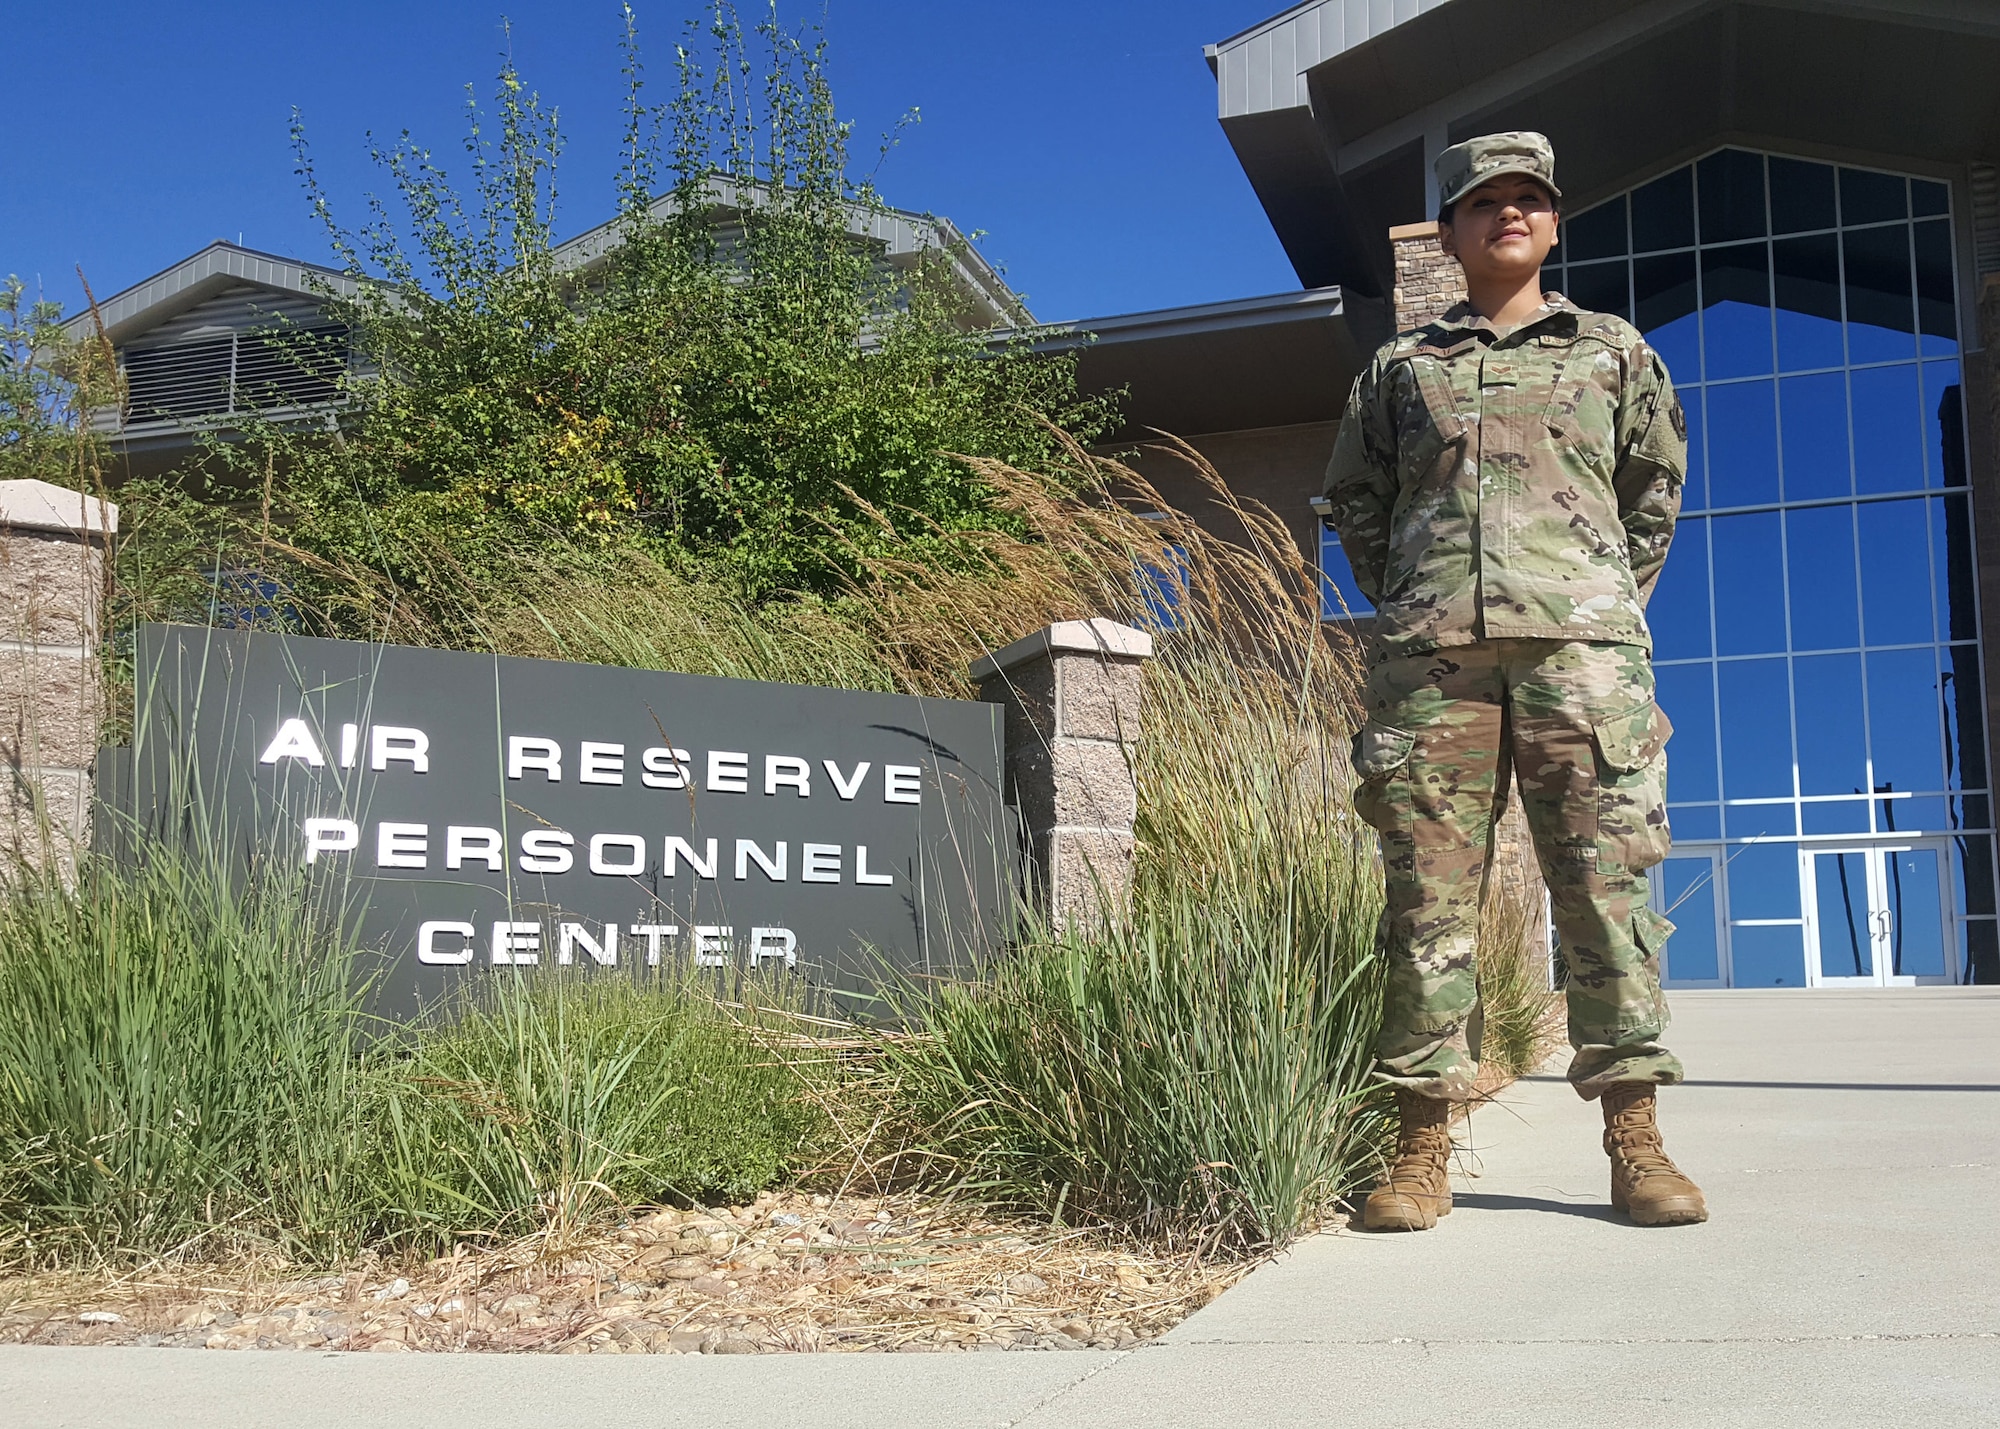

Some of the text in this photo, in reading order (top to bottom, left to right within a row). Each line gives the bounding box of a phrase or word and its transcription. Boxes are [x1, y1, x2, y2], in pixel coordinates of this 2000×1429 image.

[260, 718, 921, 804] AIR RESERVE
[305, 817, 894, 885] PERSONNEL
[417, 920, 798, 968] CENTER
